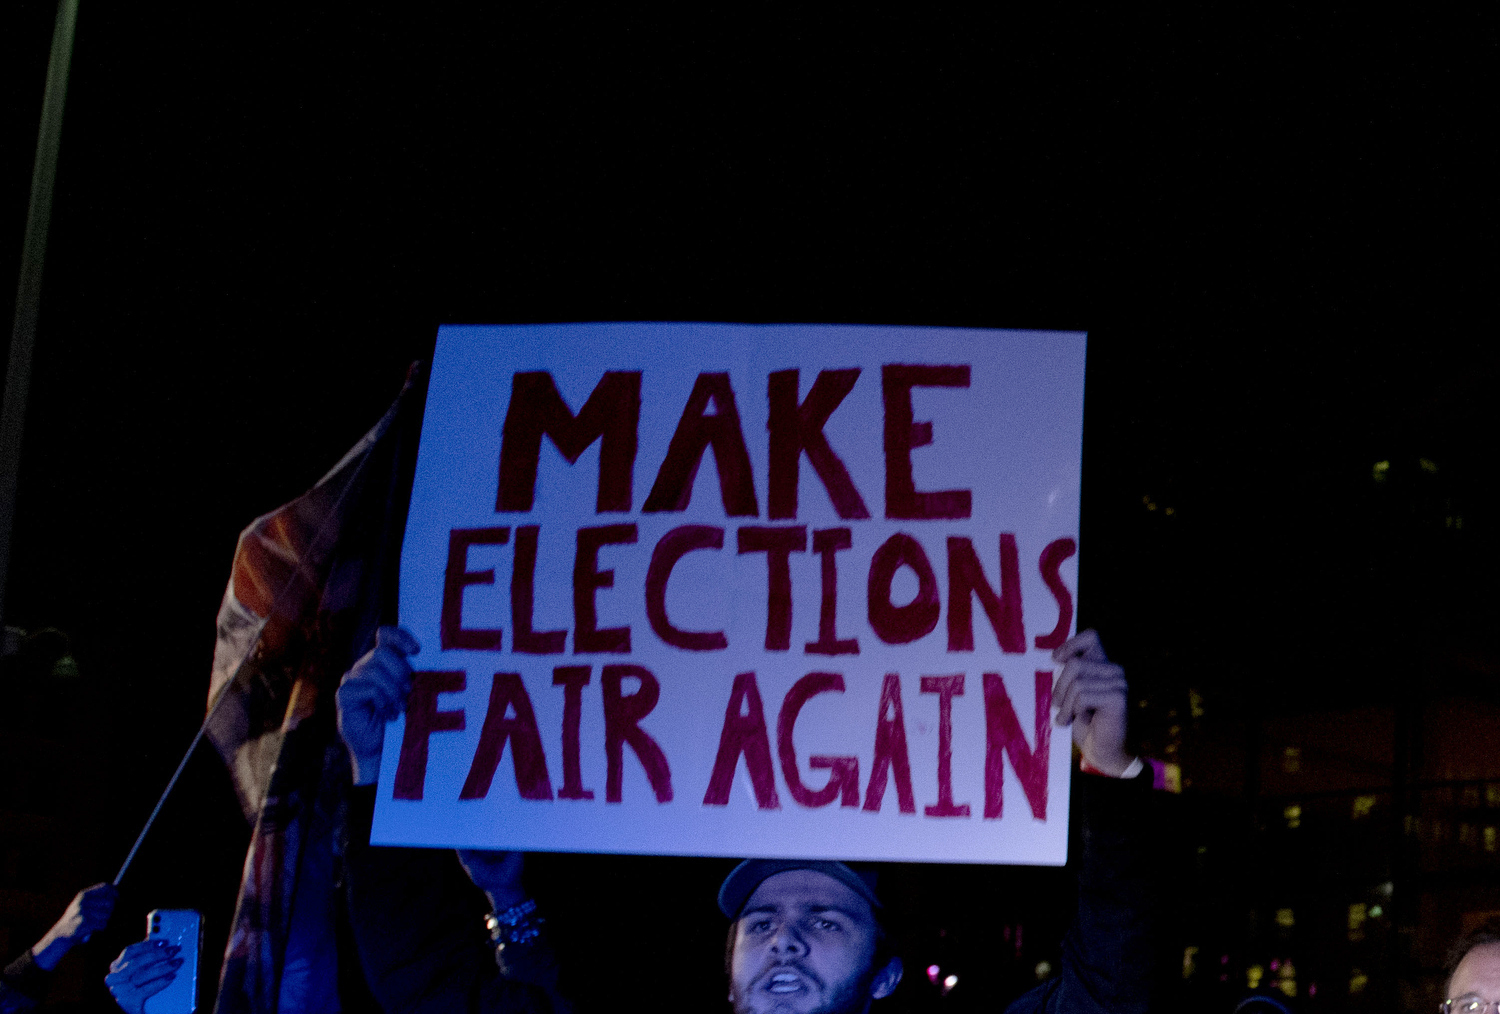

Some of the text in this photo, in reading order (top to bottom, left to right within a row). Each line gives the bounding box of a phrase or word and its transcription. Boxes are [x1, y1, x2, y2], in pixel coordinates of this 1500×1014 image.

[494, 363, 973, 521] MAKE
[440, 523, 1076, 655] ELECTIONS
[392, 664, 1054, 822] FAIR AGAIN
